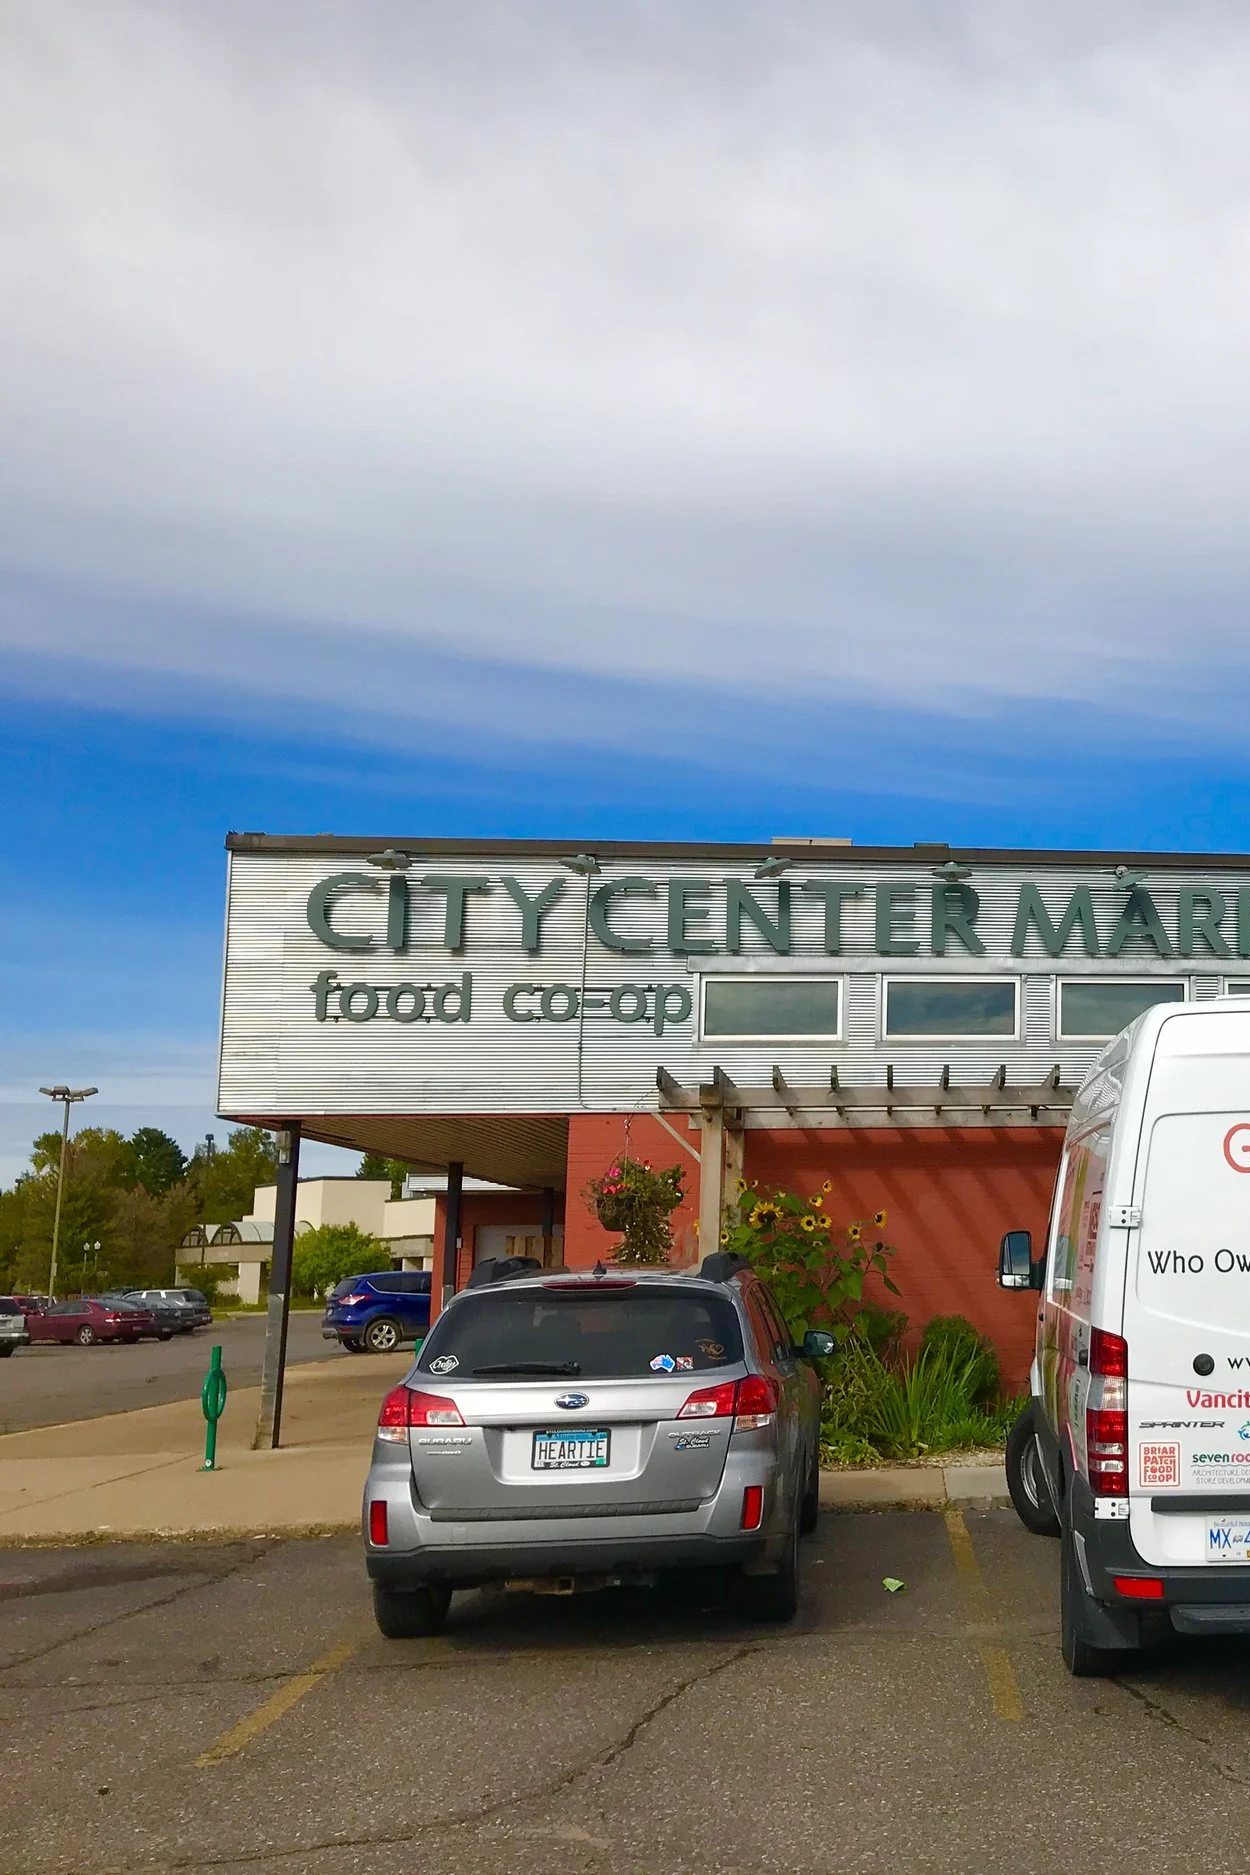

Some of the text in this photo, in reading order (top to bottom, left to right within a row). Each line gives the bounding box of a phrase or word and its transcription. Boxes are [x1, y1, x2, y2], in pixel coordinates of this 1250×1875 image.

[307, 873, 566, 950] CITY
[589, 876, 987, 956] CENTER
[310, 970, 693, 1036] food co-op
[1147, 1250, 1204, 1274] Who
[1139, 1420, 1225, 1428] SPRINTER
[418, 1437, 472, 1445] SUBARU
[538, 1440, 605, 1460] HEARTIE
[1143, 1446, 1176, 1455] BRIAR
[1209, 1528, 1232, 1549] MX
